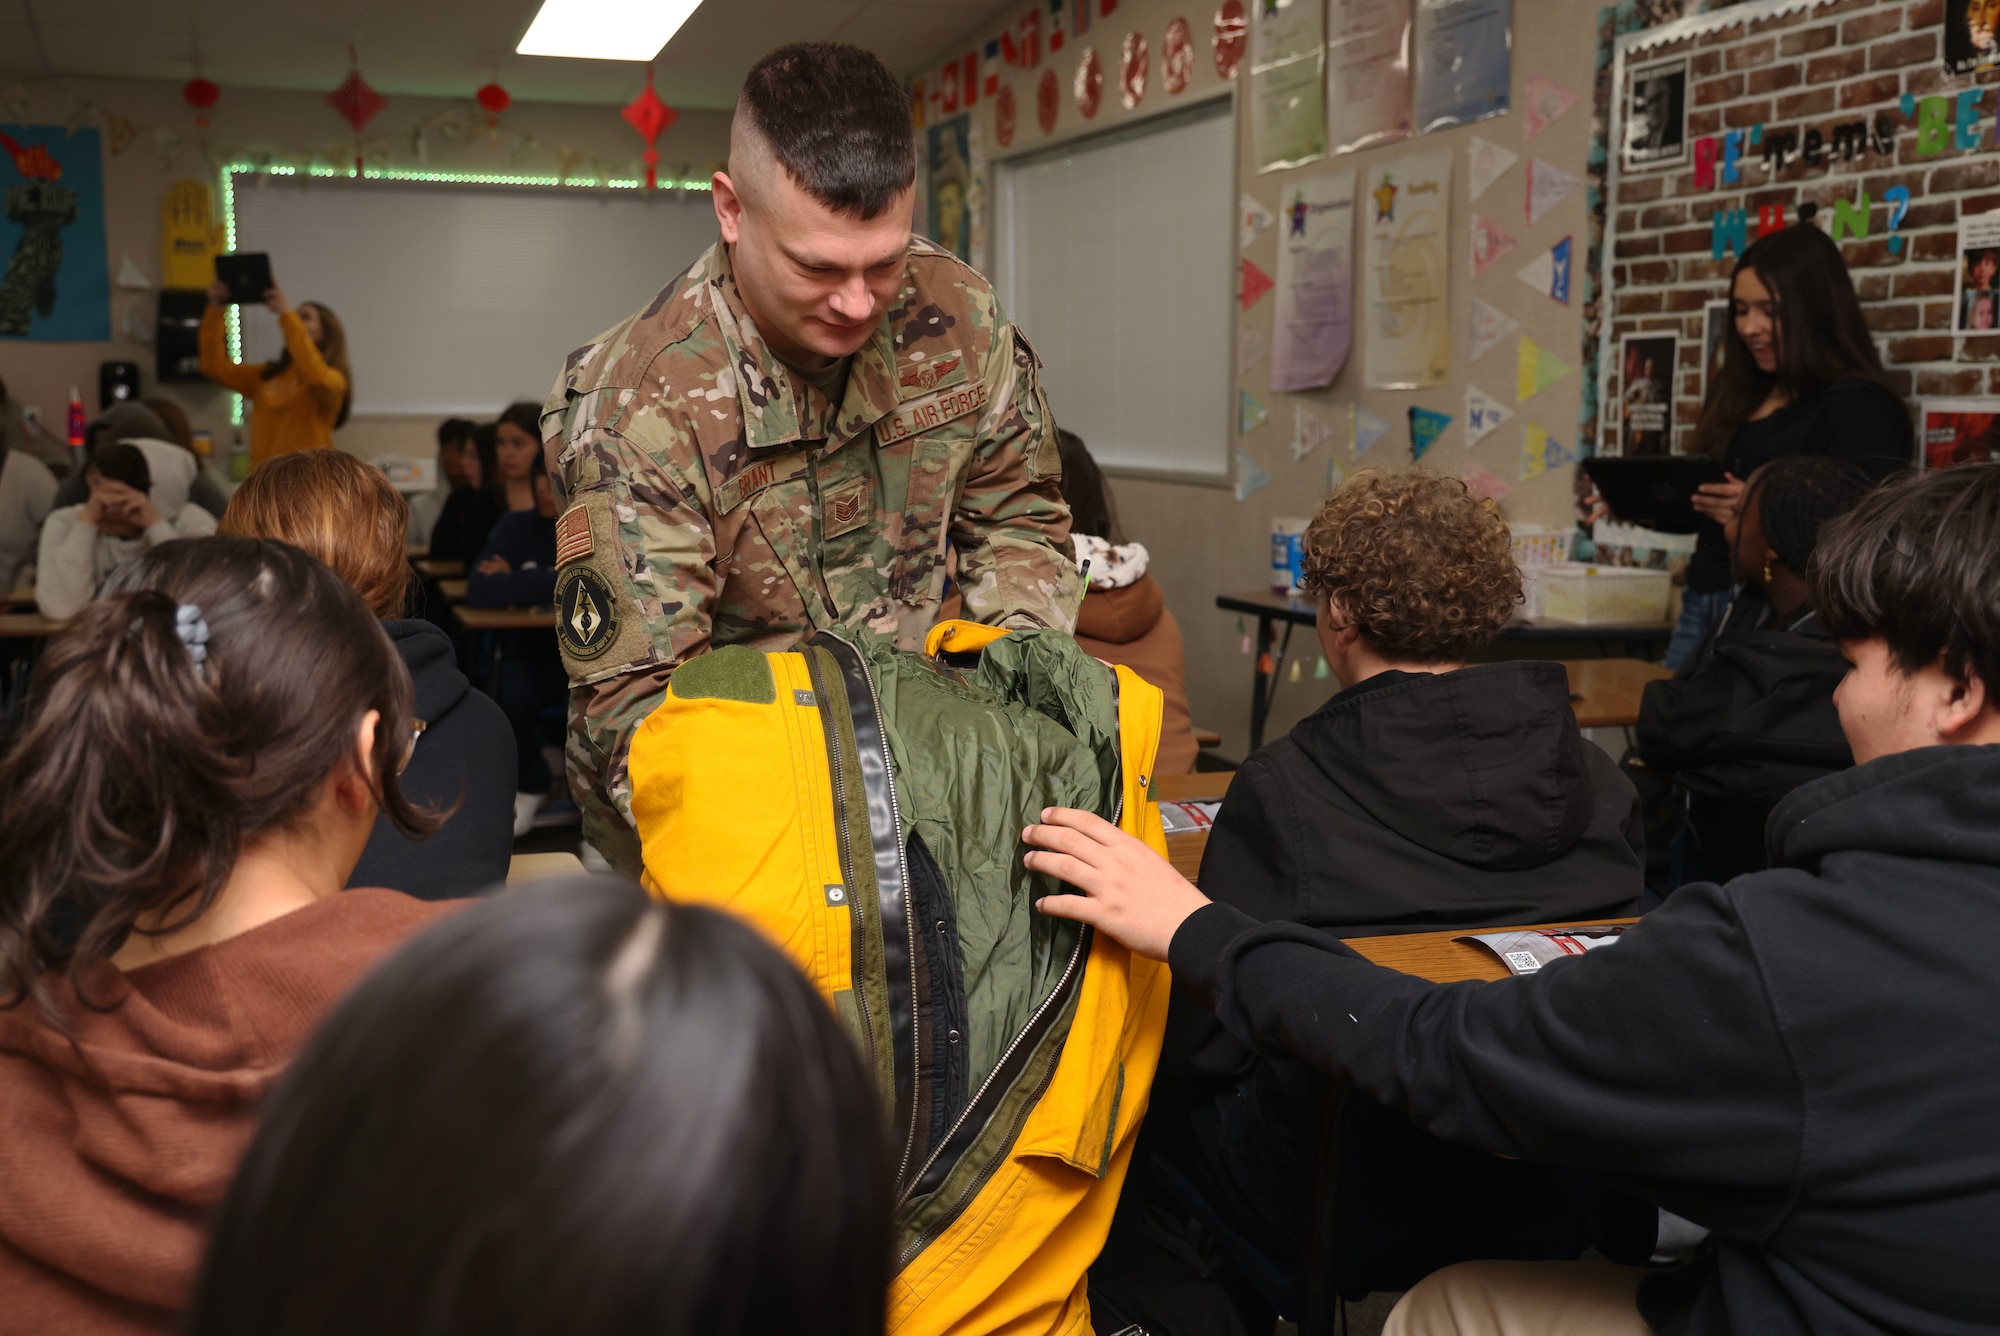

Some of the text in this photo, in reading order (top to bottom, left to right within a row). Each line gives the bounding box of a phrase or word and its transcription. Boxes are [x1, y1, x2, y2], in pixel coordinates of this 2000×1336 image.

[879, 385, 986, 443] U.S. AIR FORCE
